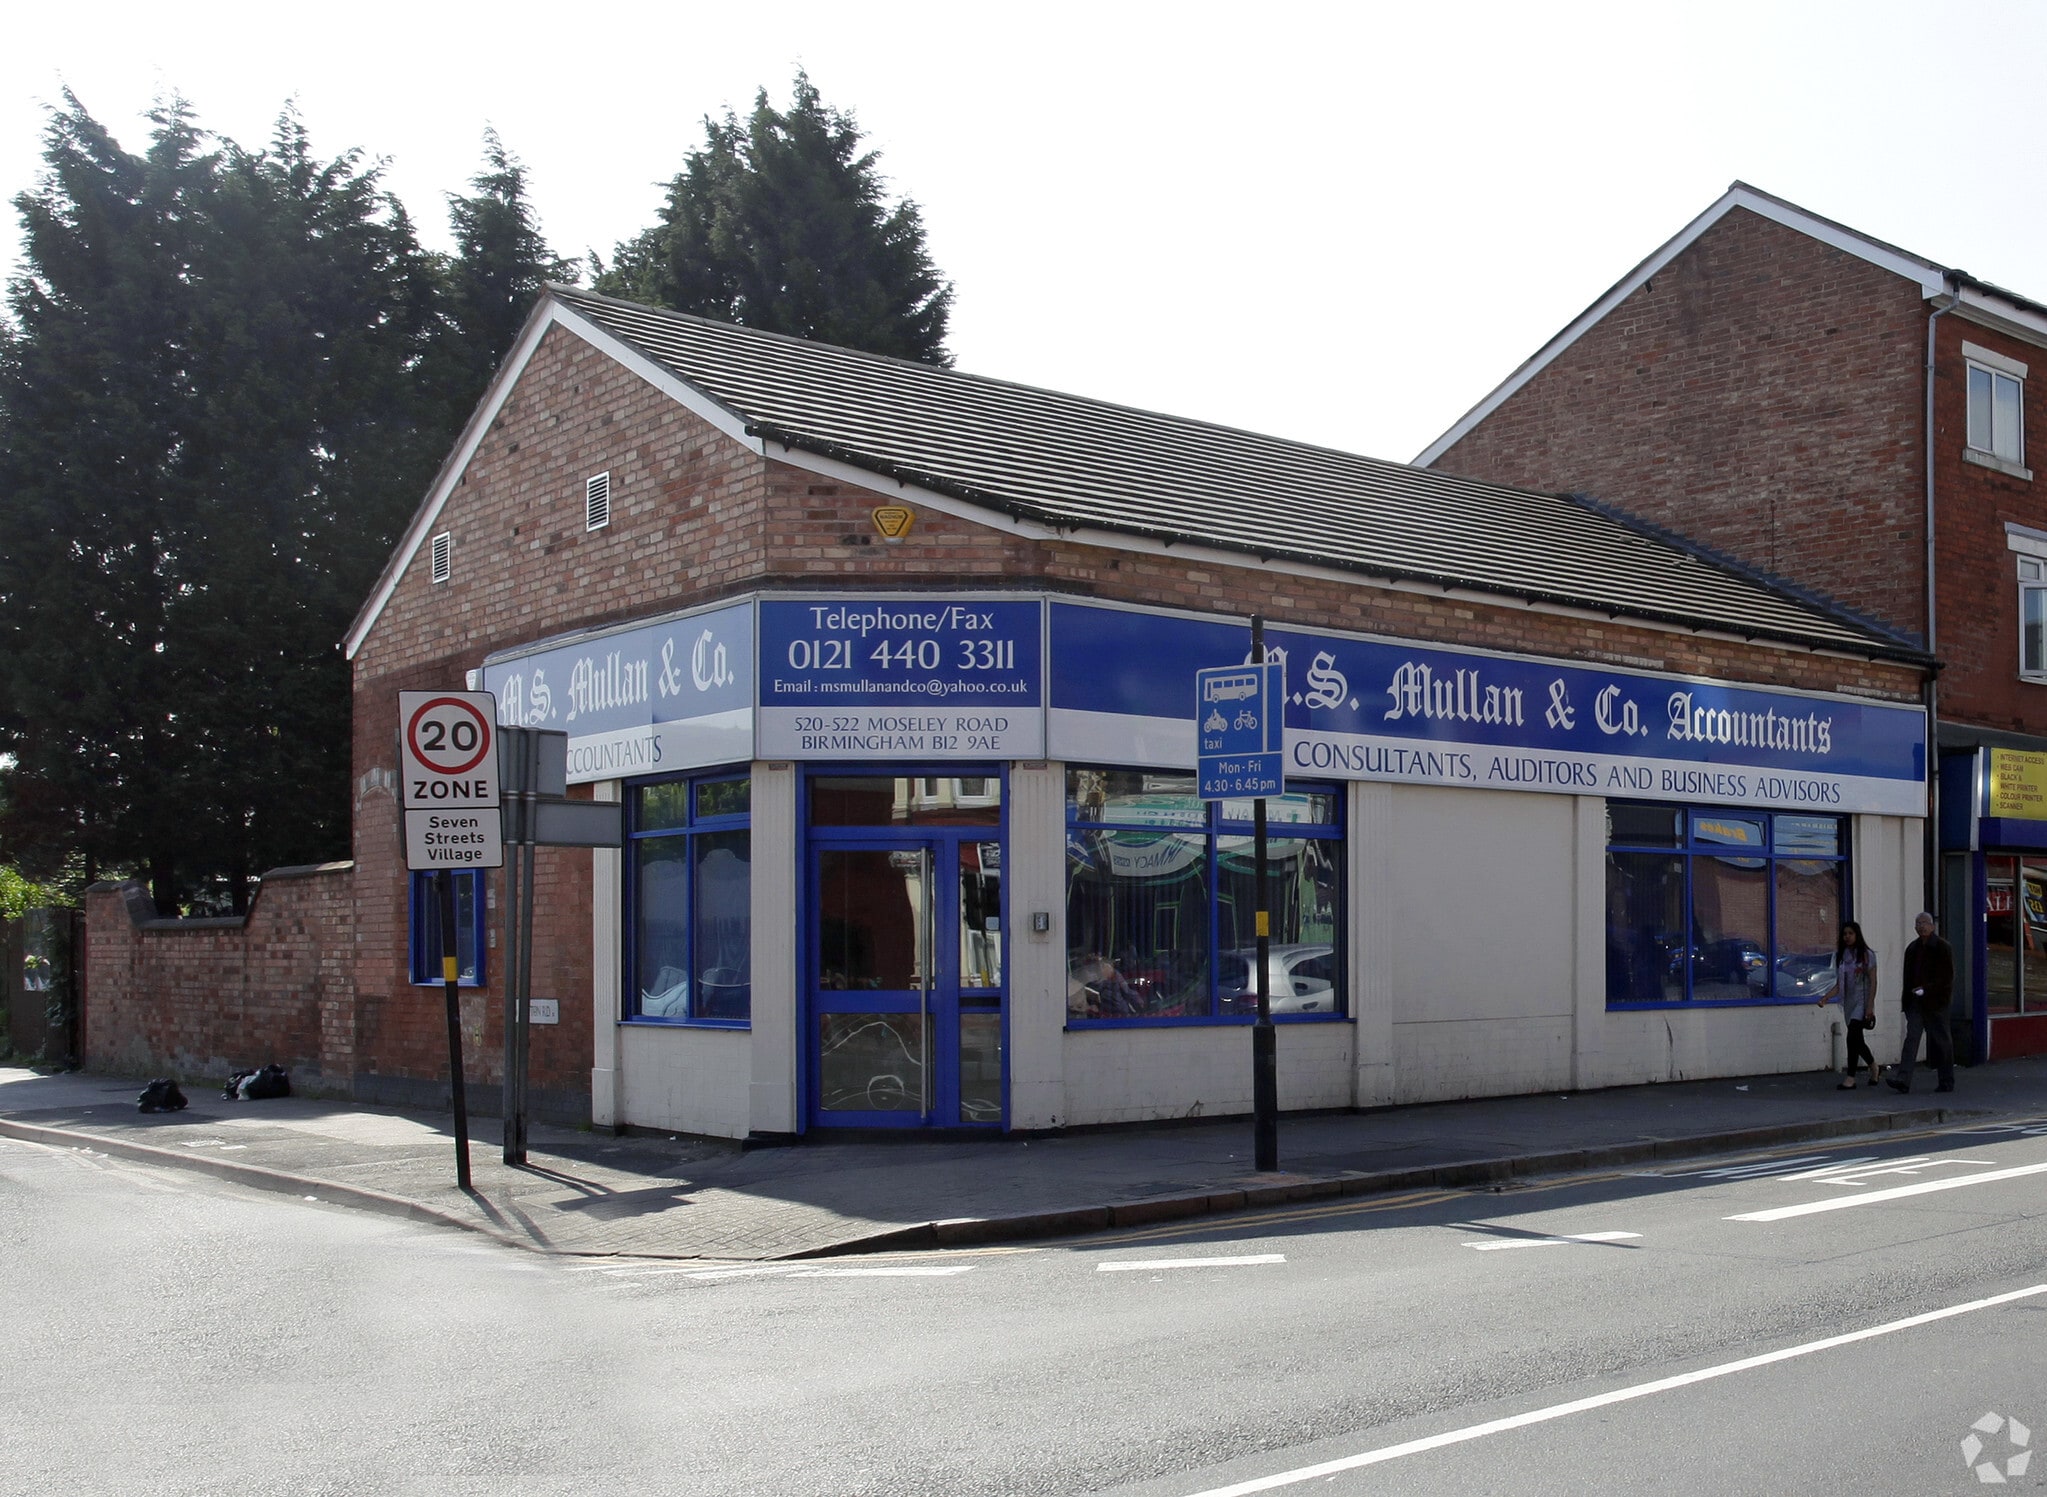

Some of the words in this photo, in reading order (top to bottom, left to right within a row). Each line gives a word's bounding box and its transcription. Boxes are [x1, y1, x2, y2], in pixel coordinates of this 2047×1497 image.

[809, 605, 994, 637] Telephone/Fax
[788, 639, 851, 669] 0121
[870, 639, 940, 669] 440
[957, 639, 1014, 669] 3311
[566, 650, 649, 722] Mullan
[658, 637, 681, 698] &
[692, 629, 734, 692] Co.
[820, 679, 1027, 696] msmullanandco@yahoo.co.uk
[1384, 661, 1524, 727] Mullan
[1545, 678, 1575, 730] &
[1594, 684, 1649, 737] Co.
[1667, 692, 1832, 754] Accountants
[794, 717, 859, 732] 520-522
[868, 717, 948, 732] MOSELEY
[955, 717, 1008, 732] ROAD
[421, 720, 478, 751] 20
[801, 735, 924, 750] BIRMINGHAM
[932, 735, 957, 750] B12
[967, 735, 1001, 750] 9AE
[1204, 737, 1223, 750] taxi
[567, 735, 662, 774] CCOUNTANTS
[1294, 741, 1477, 782] CONSULTANTS,
[1488, 755, 1597, 786] AUDITORS
[1607, 766, 1652, 790] AND
[1662, 769, 1746, 797] BUSINESS
[1755, 777, 1841, 803] ADVISORS
[413, 780, 489, 800] ZONE
[429, 815, 478, 829] Seven
[424, 831, 485, 845] Streets
[427, 848, 483, 862] Village
